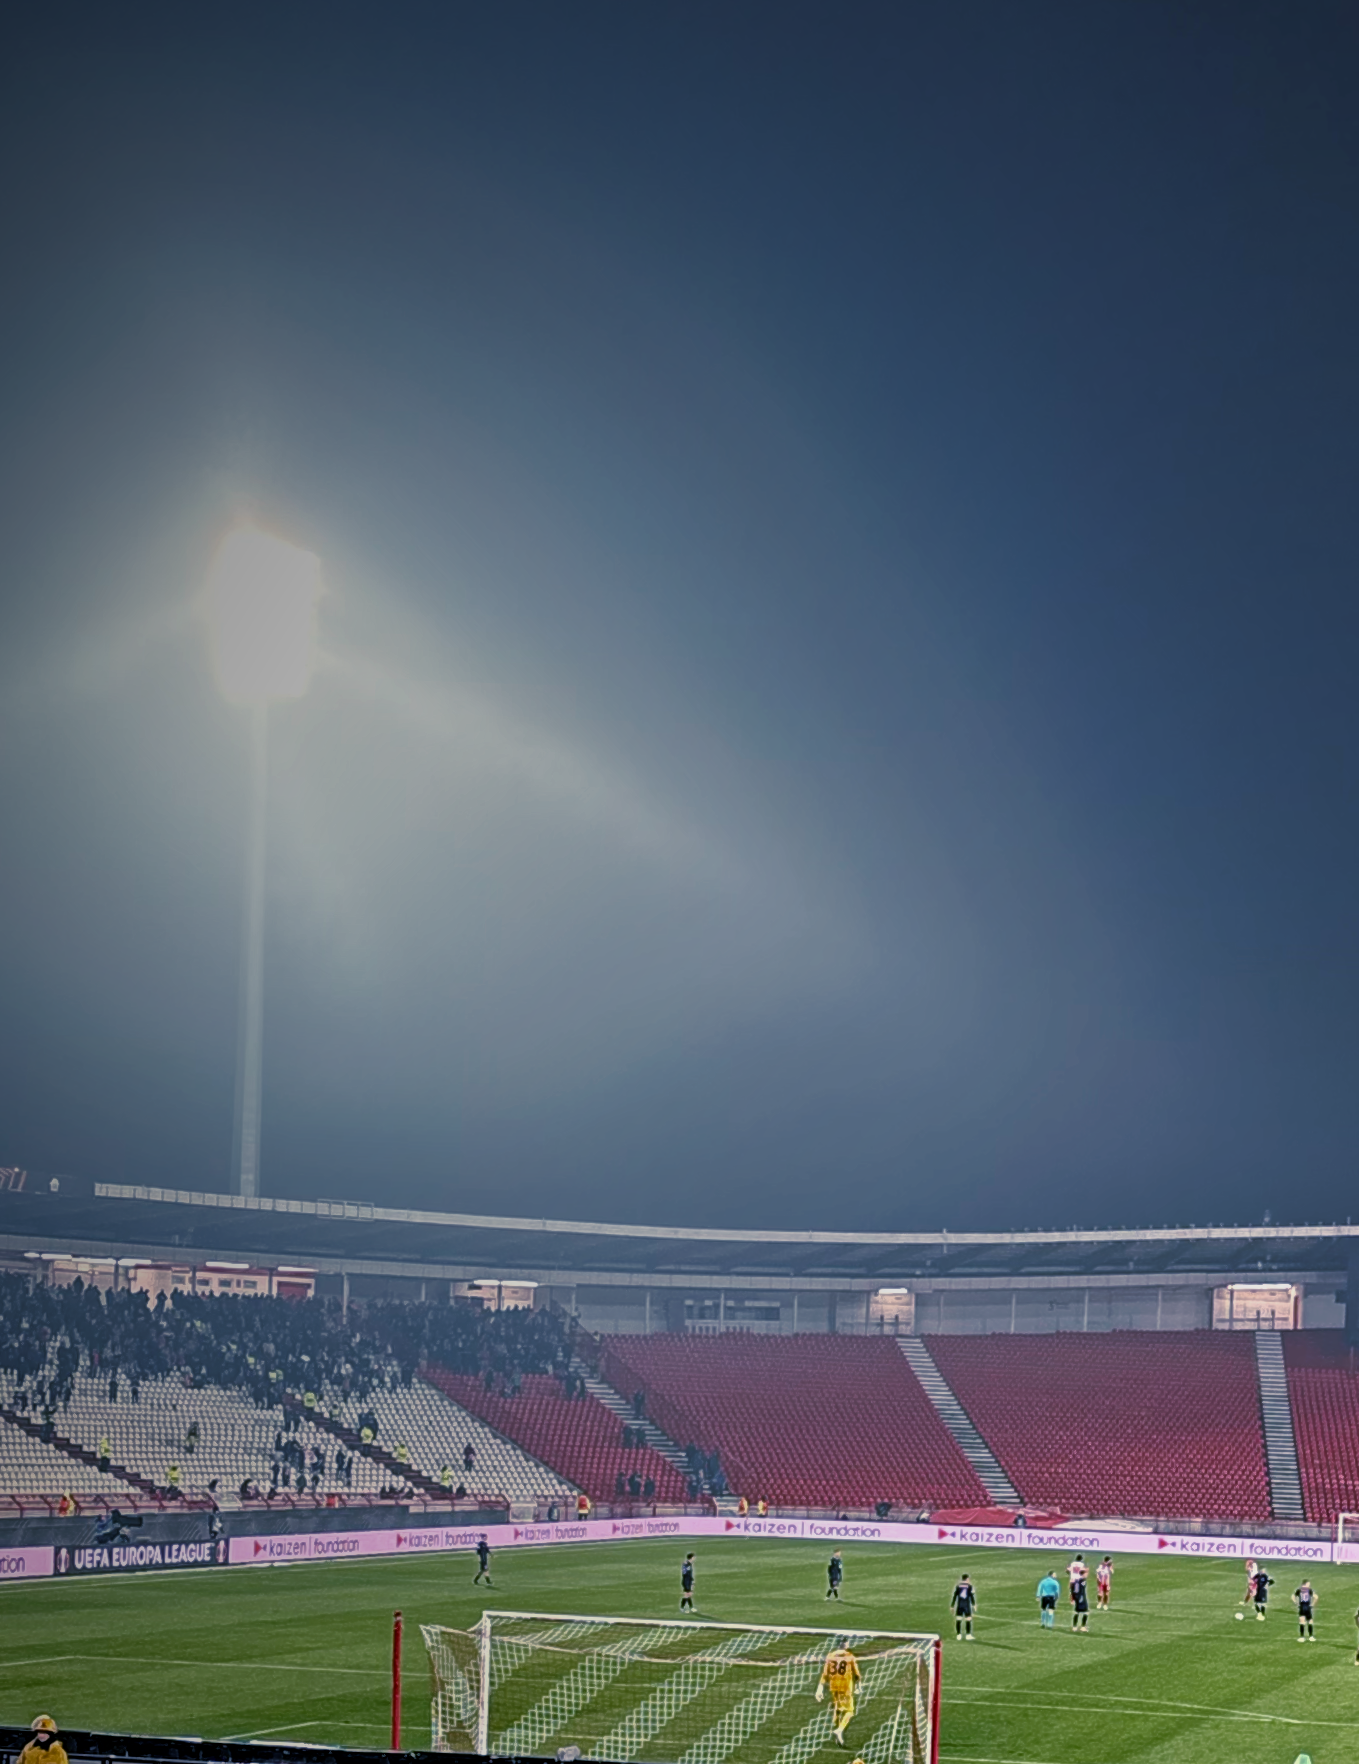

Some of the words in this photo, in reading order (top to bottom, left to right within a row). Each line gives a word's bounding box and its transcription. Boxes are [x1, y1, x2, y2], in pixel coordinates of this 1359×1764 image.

[744, 1521, 797, 1535] kaizen
[809, 1524, 881, 1538] foundation
[960, 1528, 1015, 1544] kaizen
[1027, 1532, 1100, 1548] foundation
[268, 1538, 307, 1557] kaizen
[314, 1537, 359, 1554] foundation
[408, 1532, 440, 1548] kaizen
[1181, 1538, 1236, 1554] kaizen
[1249, 1542, 1323, 1558] foundation
[74, 1547, 110, 1570] UEFA
[112, 1544, 163, 1567] EUROPA
[165, 1542, 211, 1564] LEAGUE
[828, 1660, 847, 1675] 38
